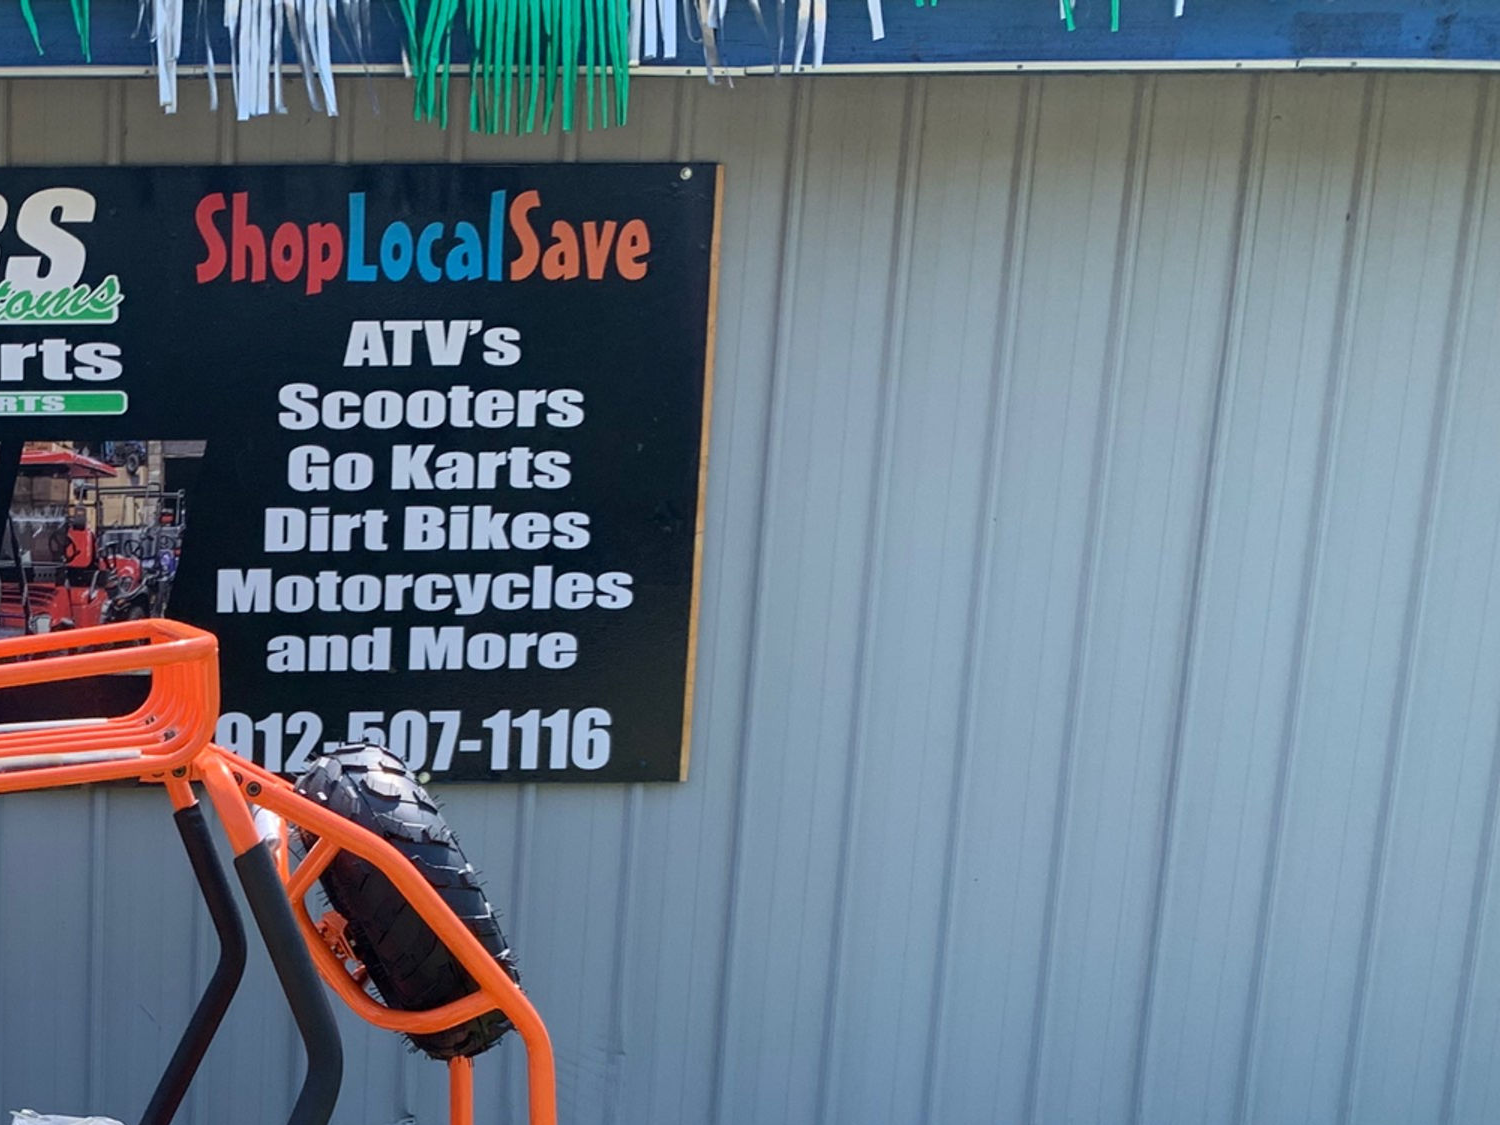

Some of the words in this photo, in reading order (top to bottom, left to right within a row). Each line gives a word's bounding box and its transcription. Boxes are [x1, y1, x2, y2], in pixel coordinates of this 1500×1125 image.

[343, 319, 522, 367] ATV's
[277, 382, 585, 431] Scooters
[287, 444, 373, 492] Go
[391, 444, 572, 490] Karts
[264, 507, 388, 552] Dirt
[403, 505, 591, 551] Bikes
[216, 565, 634, 615] Motorcycles
[266, 627, 392, 672] and
[408, 625, 578, 671] More
